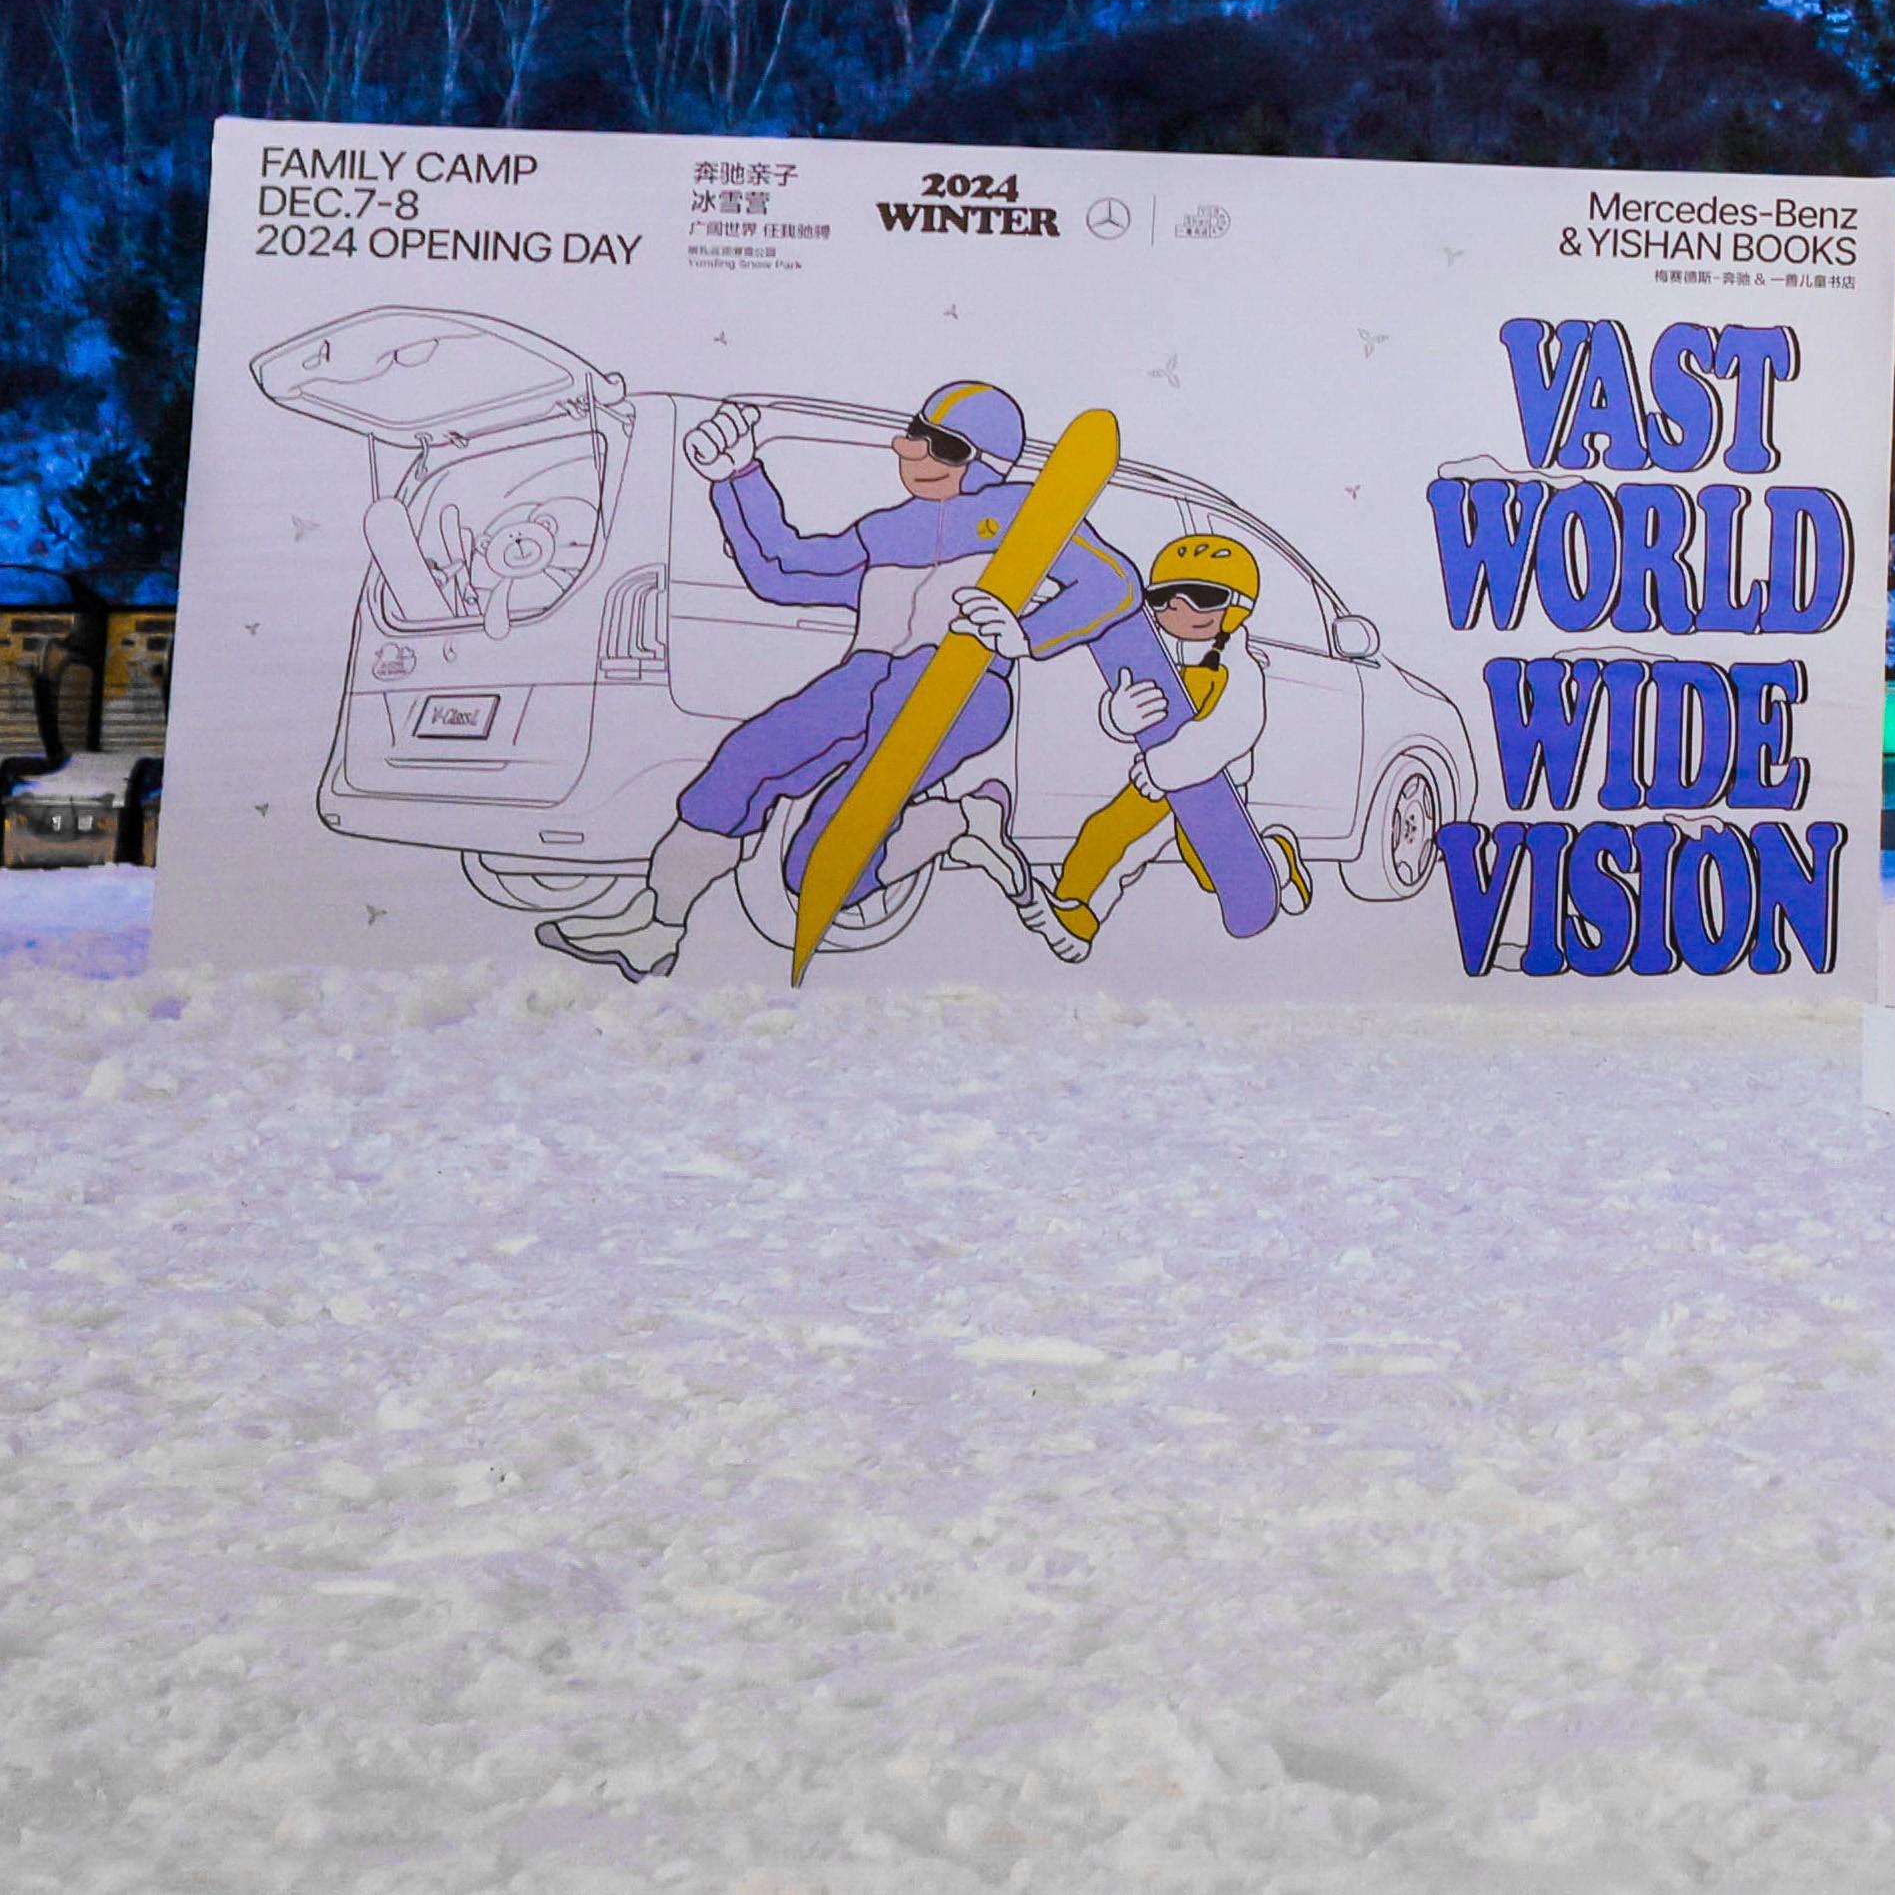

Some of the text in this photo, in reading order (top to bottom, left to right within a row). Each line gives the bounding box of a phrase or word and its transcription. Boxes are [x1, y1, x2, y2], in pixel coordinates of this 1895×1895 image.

[260, 146, 539, 186] FAMILY CAMP
[693, 161, 799, 187] 奔驰亲子
[258, 185, 421, 222] DEC.7-8
[691, 189, 771, 215] 冰雪营
[921, 172, 1020, 203] 2024
[875, 201, 1061, 237] WINTER
[1589, 191, 1859, 231] Mercedes-Benz
[255, 223, 644, 266] 2024 OPENING DAY
[1558, 226, 1858, 266] & YISHAN BOOKS
[1500, 318, 1801, 473] VAST
[1426, 476, 1855, 635] WORLD
[1484, 657, 1811, 811] WIDE
[1436, 821, 1848, 977] VISION
